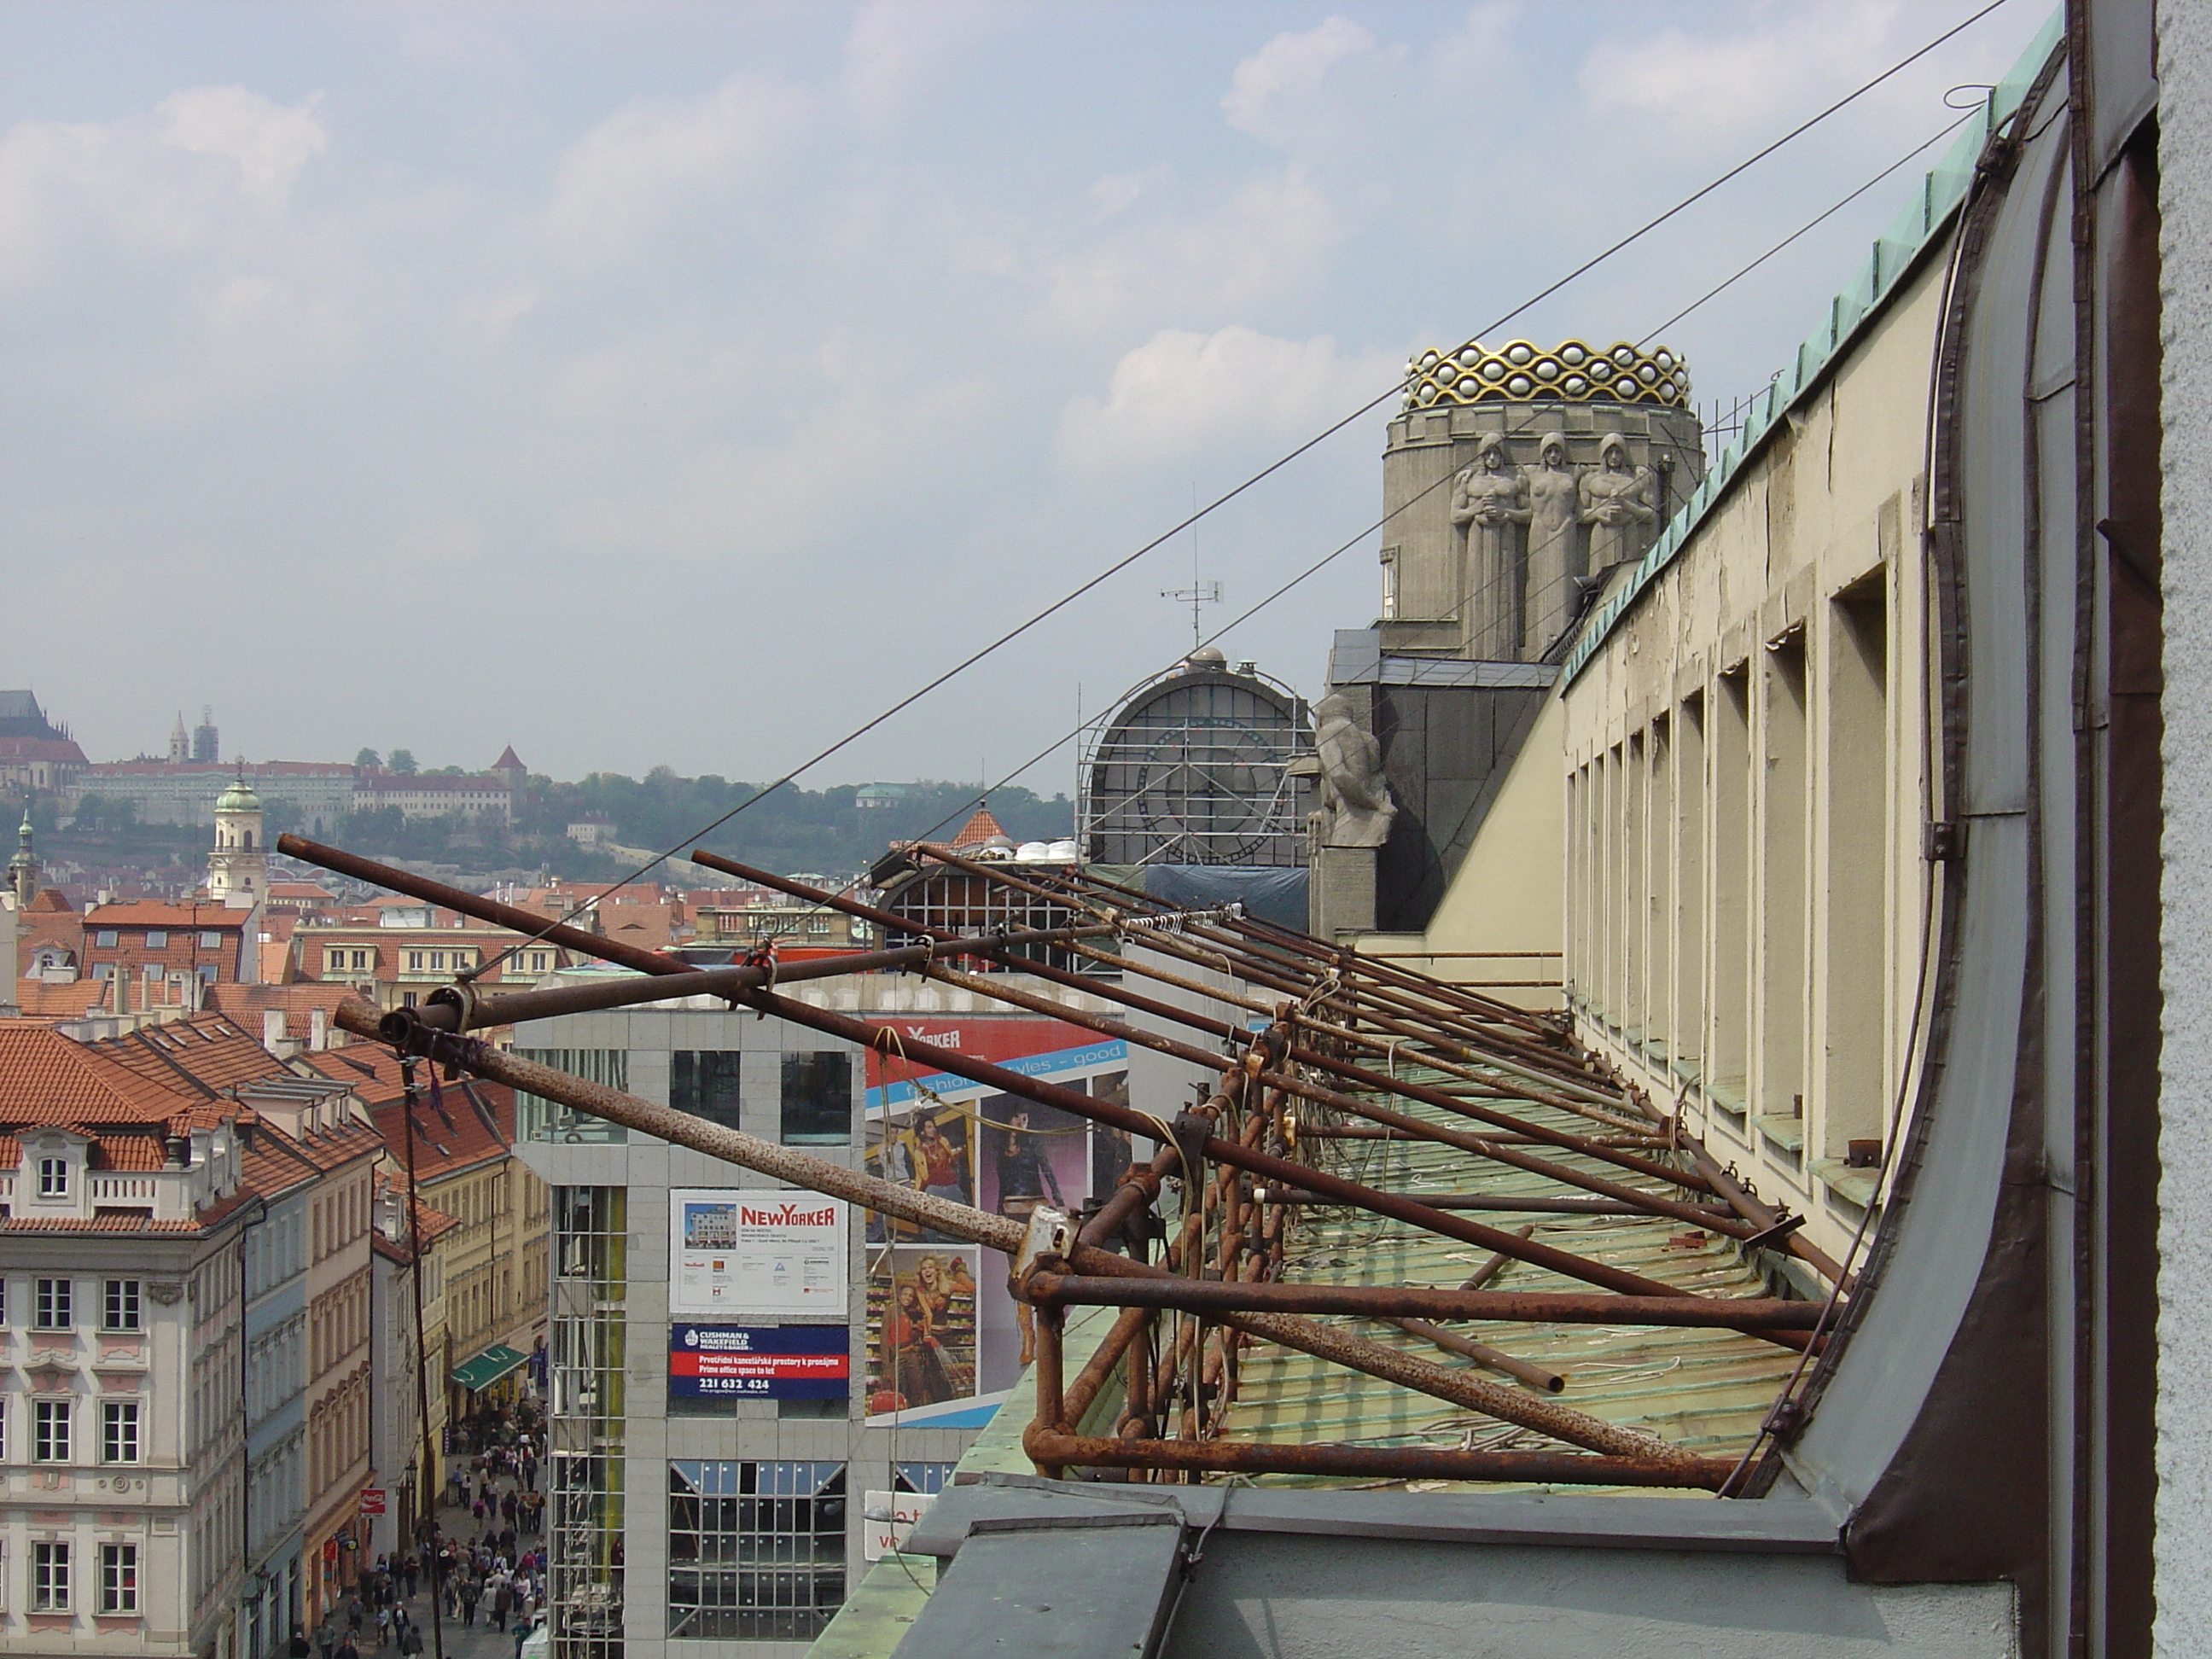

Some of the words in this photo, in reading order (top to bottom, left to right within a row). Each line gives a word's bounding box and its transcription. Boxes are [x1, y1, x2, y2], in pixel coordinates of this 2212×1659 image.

[906, 1077, 975, 1097] fshio
[1008, 1060, 1051, 1074] yles
[1074, 1045, 1121, 1067] good
[772, 1358, 801, 1368] prostory
[699, 1365, 719, 1373] Prime
[719, 1365, 737, 1374] office
[738, 1367, 756, 1376] space
[765, 1366, 775, 1375] let
[700, 1378, 719, 1388] 221
[721, 1378, 743, 1388] 632
[748, 1379, 770, 1389] 424
